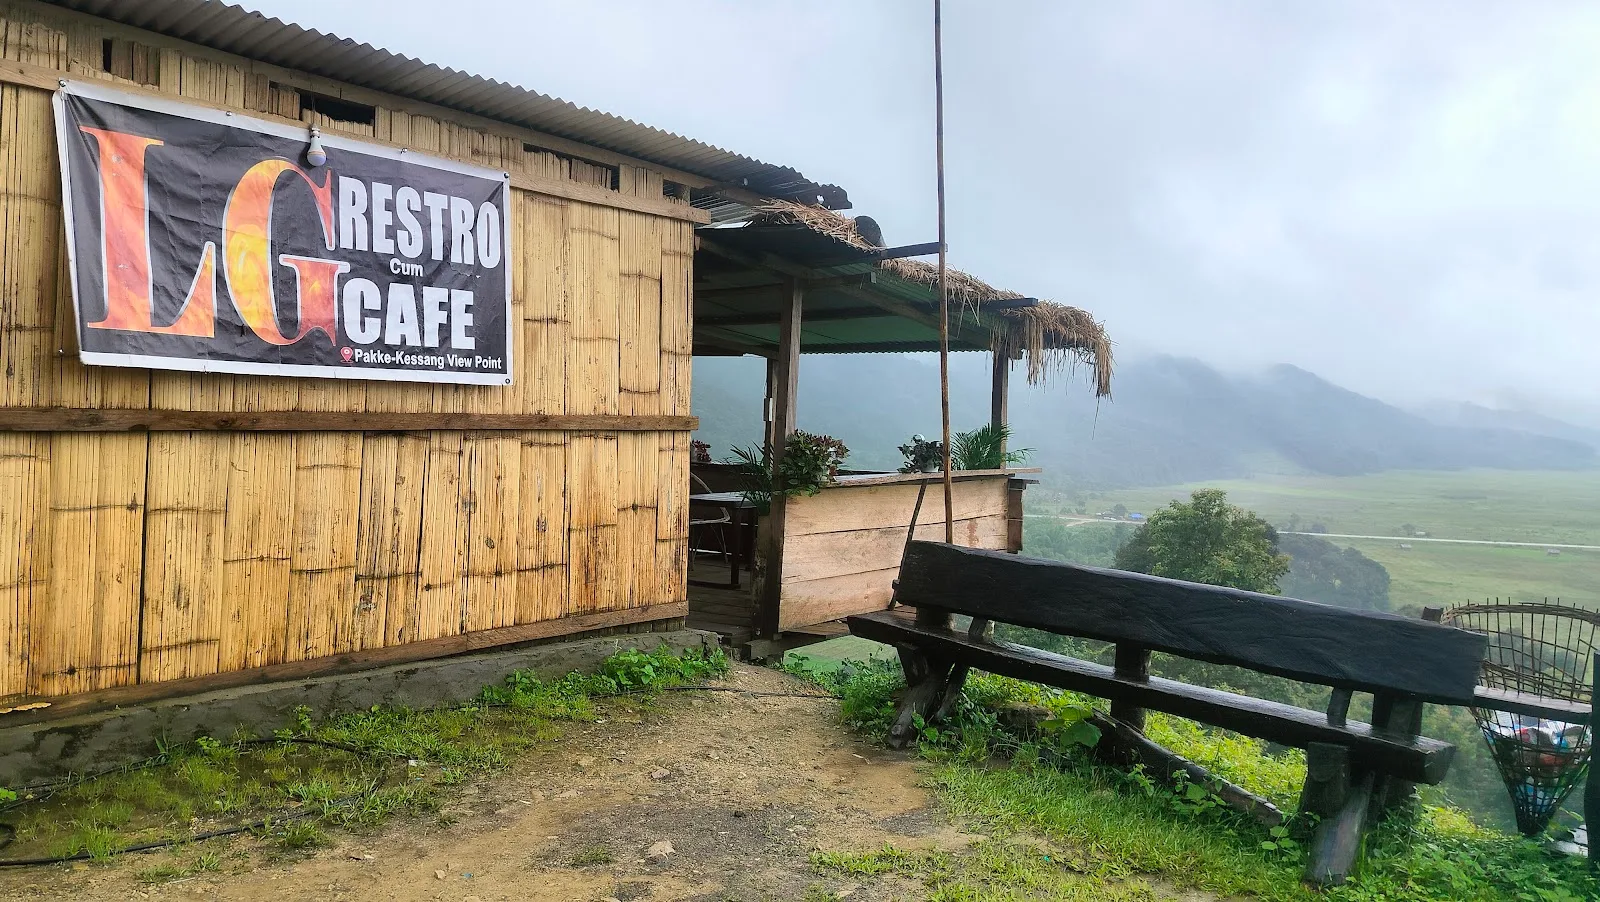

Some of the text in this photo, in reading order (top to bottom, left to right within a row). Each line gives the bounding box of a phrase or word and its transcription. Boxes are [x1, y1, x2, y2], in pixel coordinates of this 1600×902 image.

[80, 126, 349, 347] LG
[339, 176, 501, 269] RESTRO
[389, 257, 424, 277] Cum
[342, 277, 476, 350] CAFE
[354, 349, 502, 370] Pakke-Kessang View Point
